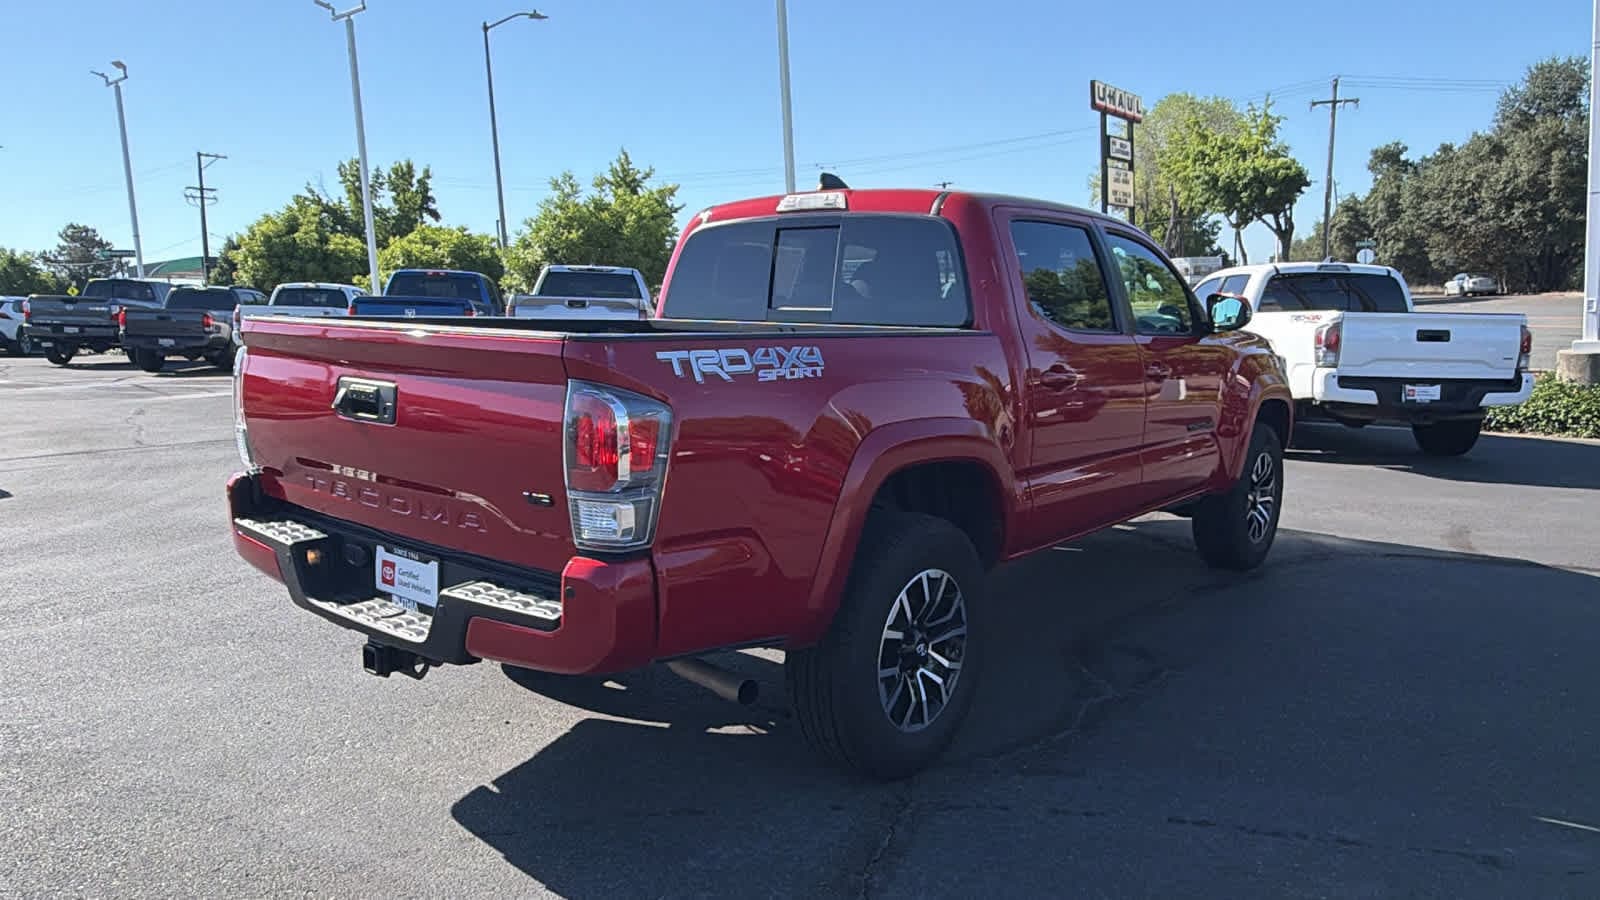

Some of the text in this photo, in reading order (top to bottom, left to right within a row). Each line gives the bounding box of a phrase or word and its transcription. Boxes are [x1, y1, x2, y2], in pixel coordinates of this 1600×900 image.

[656, 348, 754, 384] TRD
[758, 366, 824, 382] SPORT
[305, 474, 488, 532] TACOMA
[398, 568, 419, 580] Certified
[398, 576, 410, 588] Used
